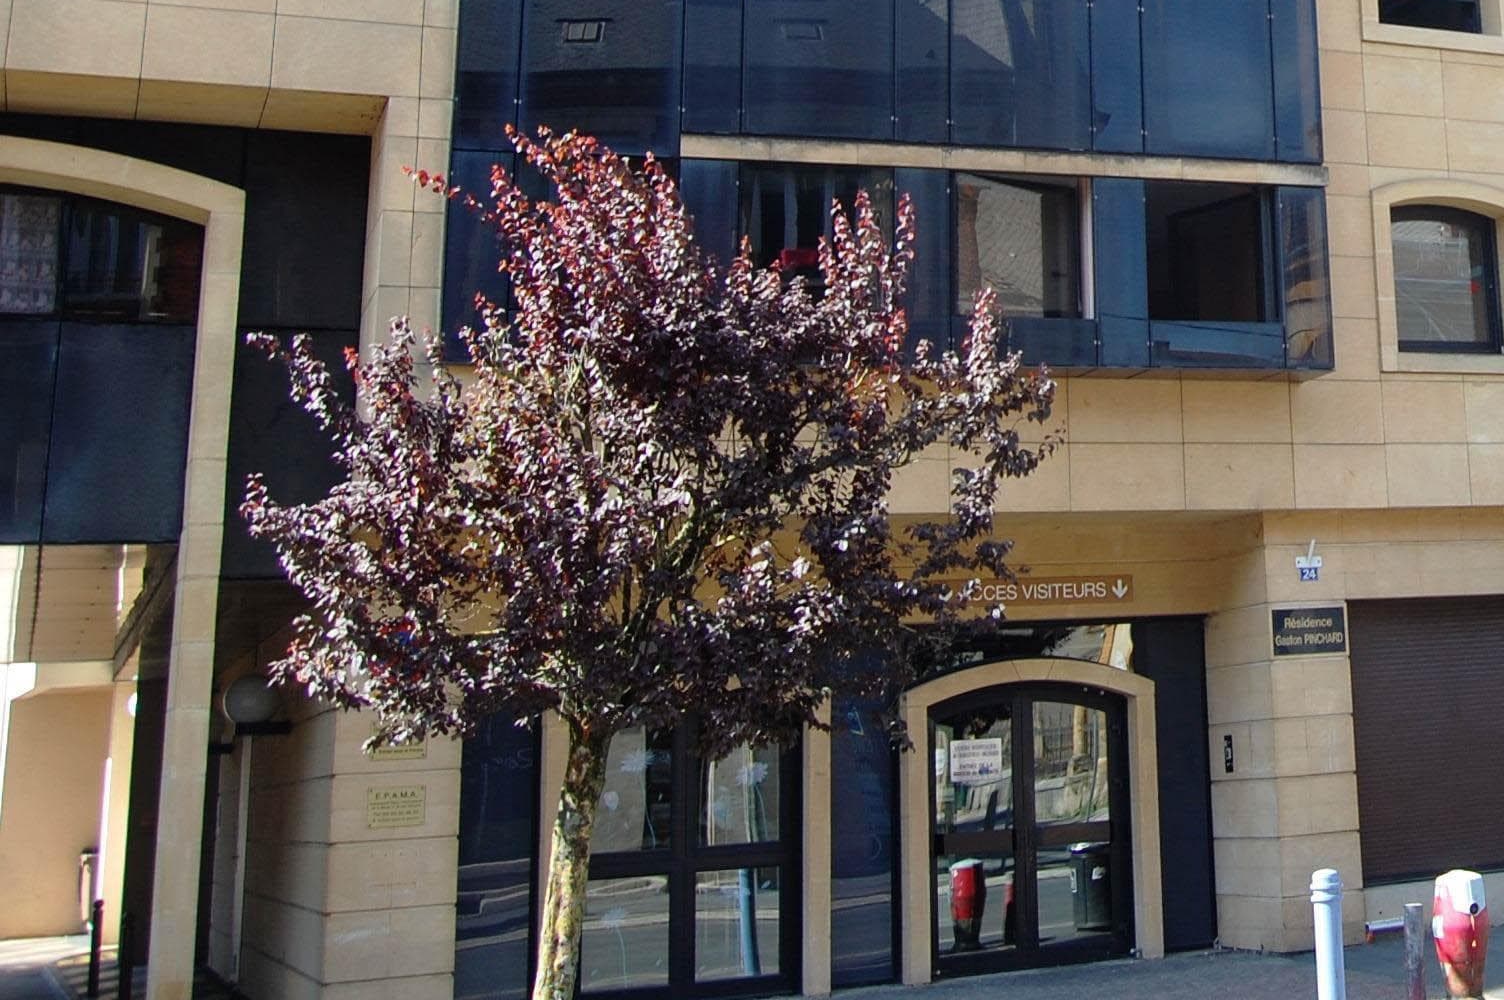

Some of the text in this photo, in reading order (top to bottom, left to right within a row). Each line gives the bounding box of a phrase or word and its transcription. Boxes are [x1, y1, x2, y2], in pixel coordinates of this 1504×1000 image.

[1302, 568, 1317, 580] 24
[957, 582, 1107, 601] CCES VISITEURS
[1283, 616, 1333, 629] Résidence
[1275, 631, 1344, 647] Gaston PINCHARD
